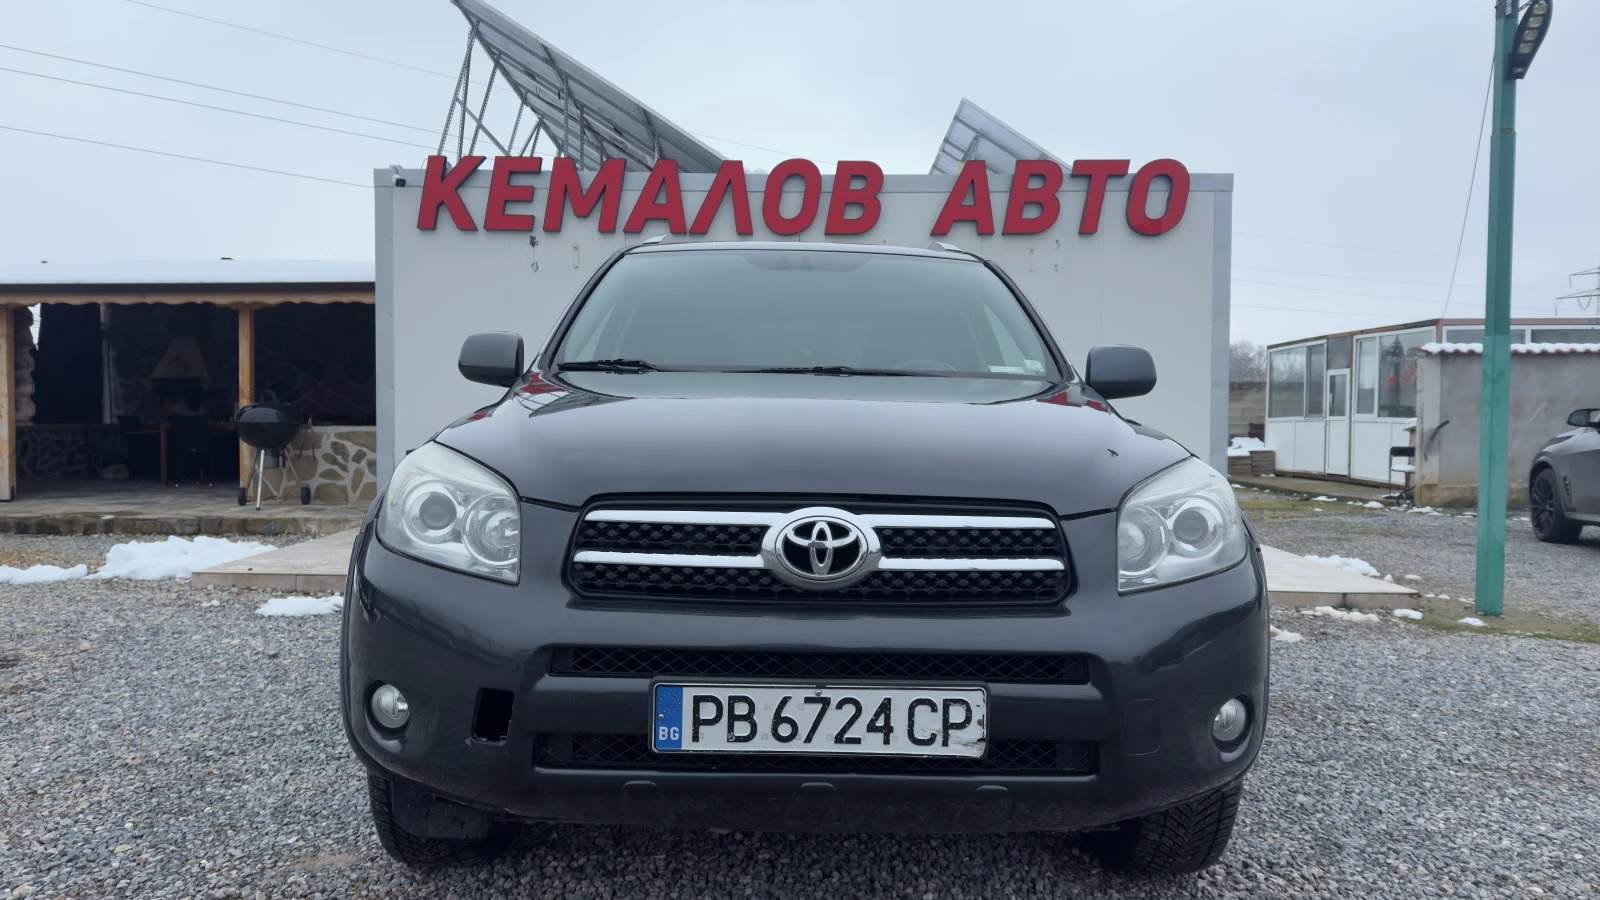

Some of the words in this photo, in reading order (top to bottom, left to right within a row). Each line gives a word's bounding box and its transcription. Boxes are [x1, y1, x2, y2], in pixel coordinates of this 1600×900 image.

[417, 155, 884, 235] КЕМАЛОВ
[930, 158, 1191, 236] АВТО
[658, 726, 680, 741] BG
[691, 694, 758, 743] PB
[772, 696, 894, 745] 6724
[907, 698, 973, 747] CP
